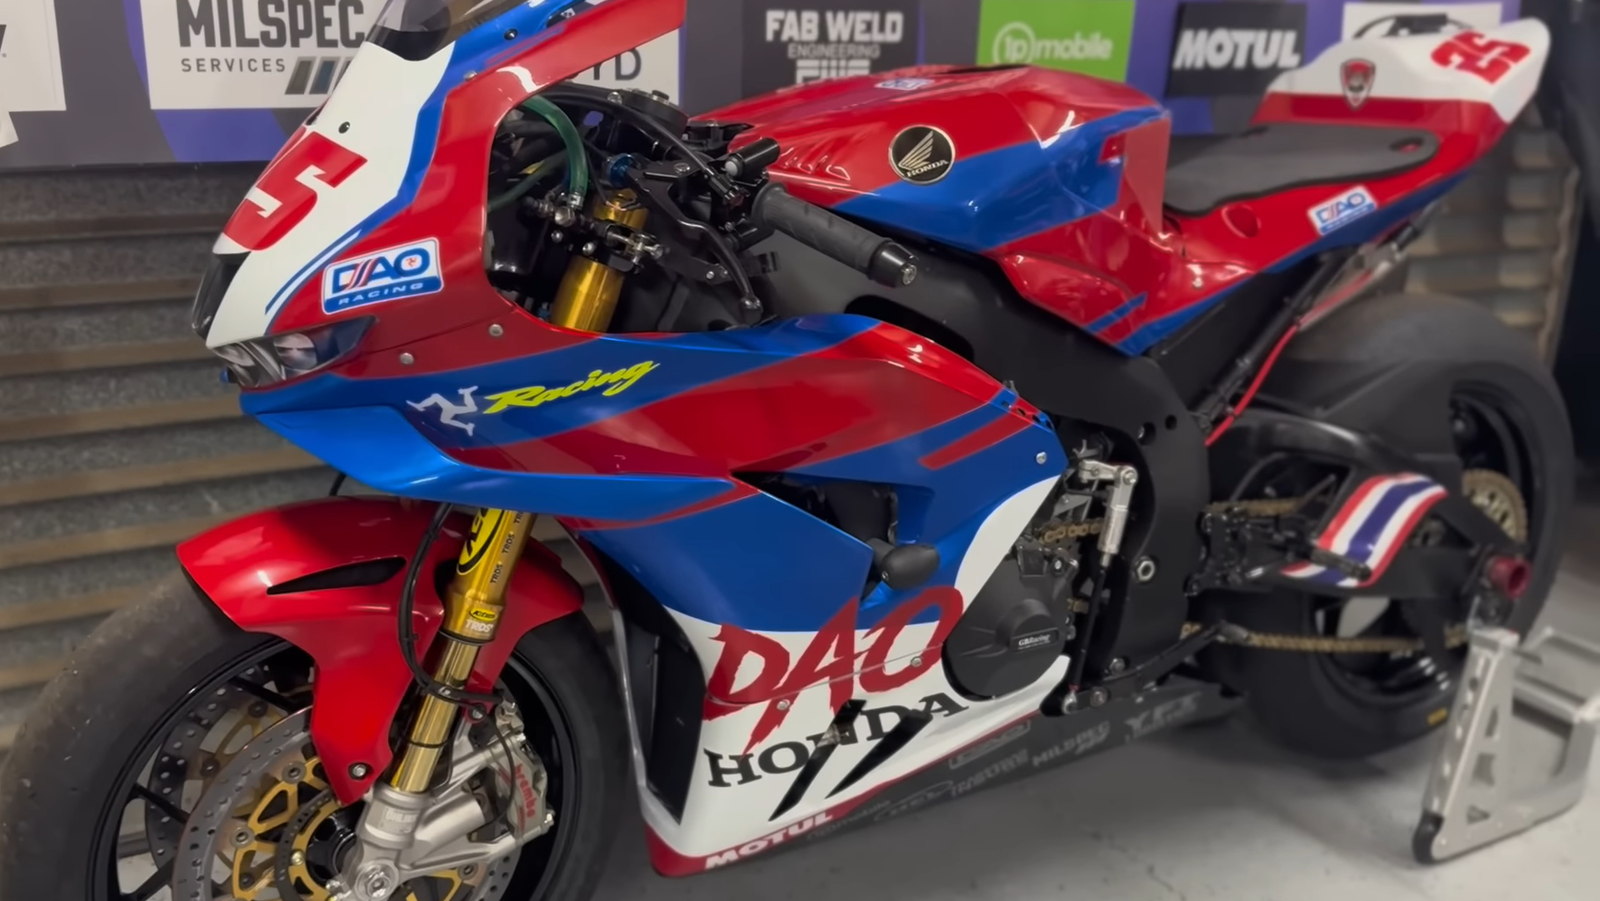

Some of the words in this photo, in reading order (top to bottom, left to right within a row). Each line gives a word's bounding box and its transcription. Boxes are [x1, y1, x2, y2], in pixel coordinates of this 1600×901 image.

[176, 0, 366, 48] MILSPEC
[766, 10, 819, 42] FAB
[825, 10, 904, 43] WELD
[181, 58, 286, 72] SERVICES
[787, 43, 881, 59] ENGINEERING
[1172, 28, 1301, 69] MOTUL
[906, 159, 949, 178] HONDA
[338, 282, 424, 306] RACING
[483, 360, 660, 415] Racing
[702, 585, 964, 763] DAO
[703, 692, 970, 788] HONDA
[705, 811, 833, 870] MOTUL
